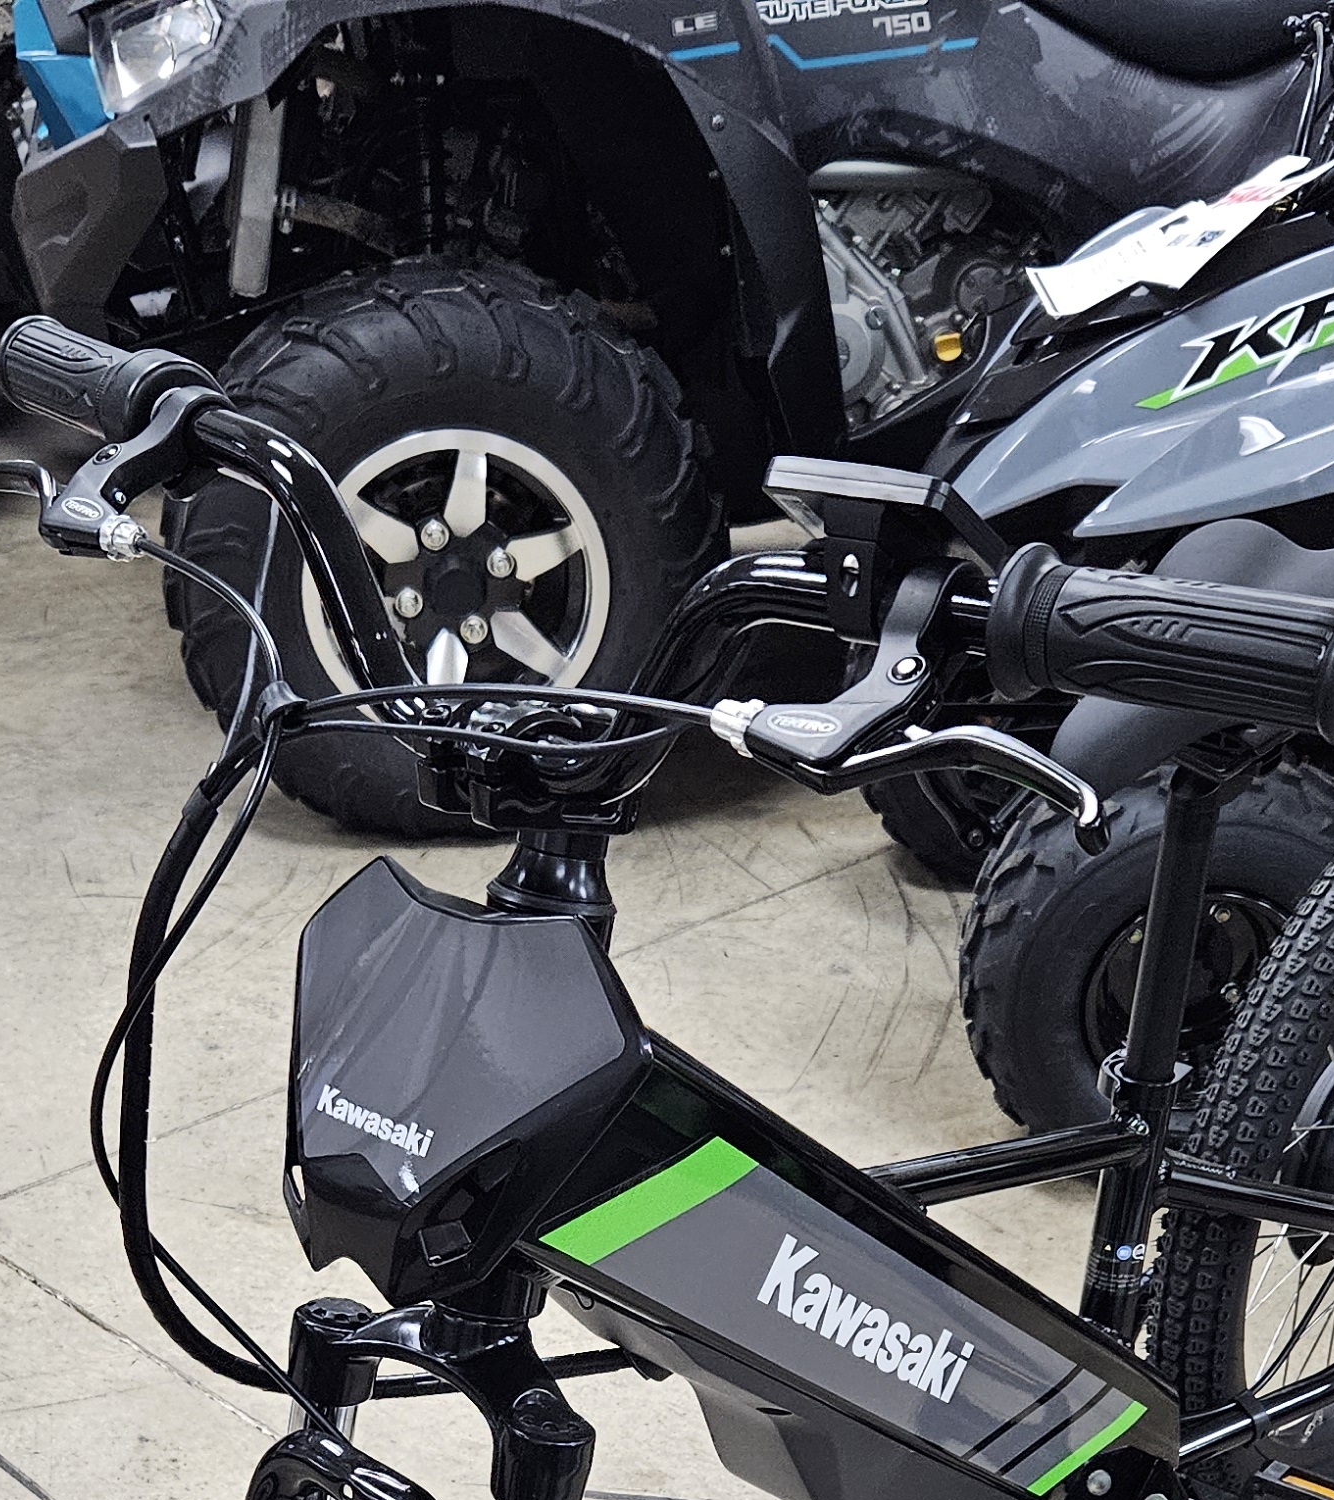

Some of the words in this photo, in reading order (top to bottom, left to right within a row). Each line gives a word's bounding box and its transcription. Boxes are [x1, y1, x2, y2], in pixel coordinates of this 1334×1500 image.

[674, 13, 717, 35] LE
[872, 11, 932, 38] 750
[316, 1084, 436, 1158] Kawasaki
[756, 1232, 975, 1404] Kawasaki
